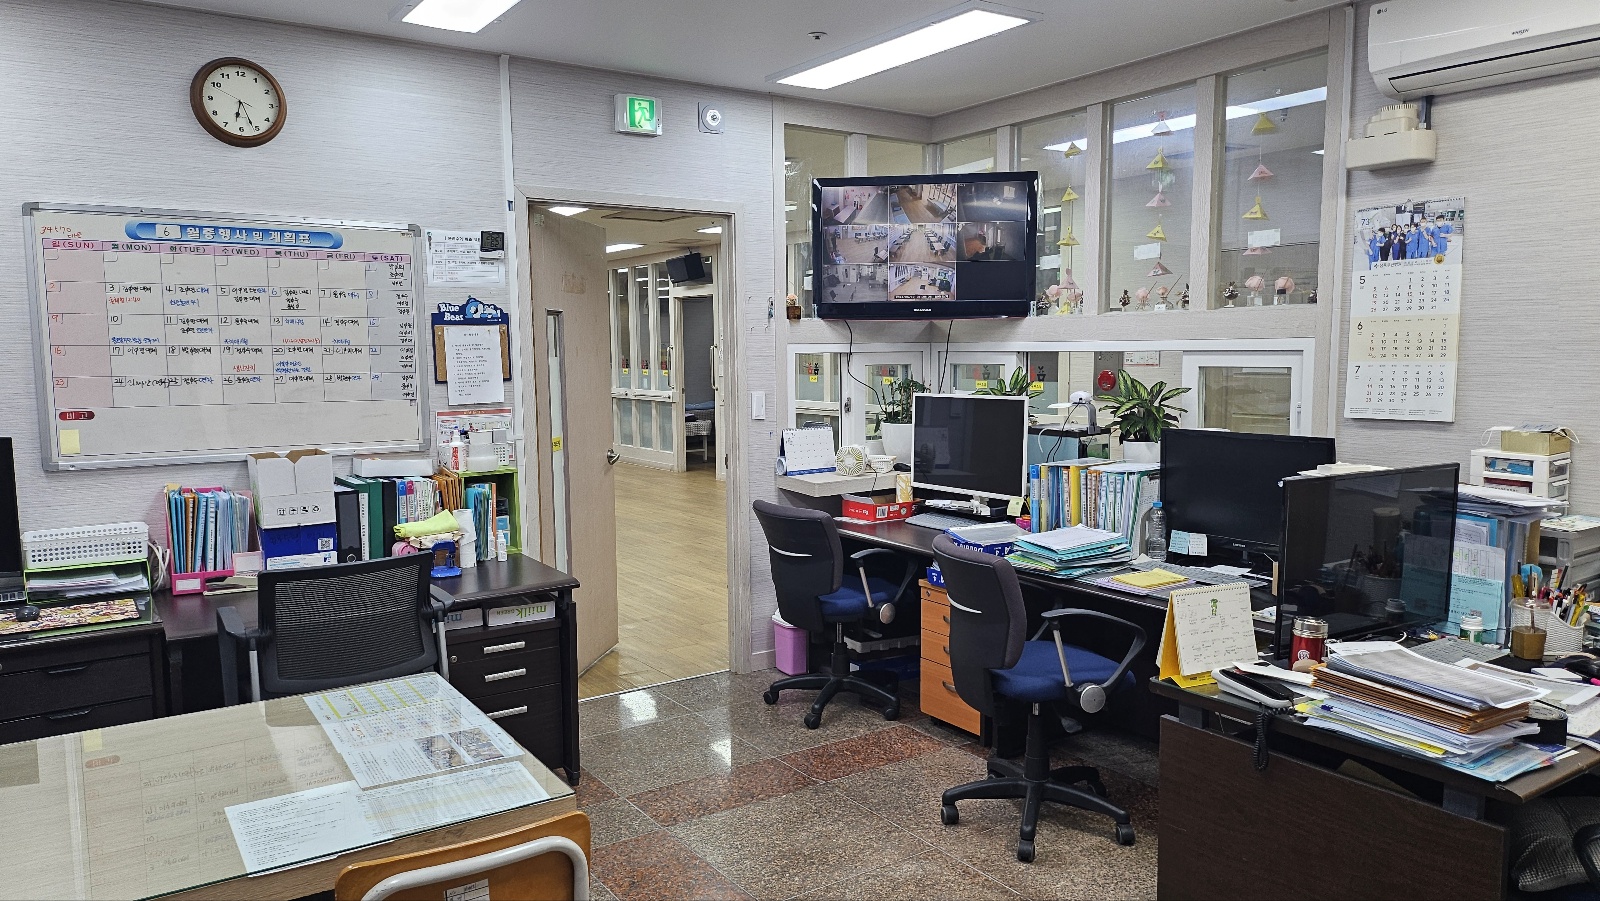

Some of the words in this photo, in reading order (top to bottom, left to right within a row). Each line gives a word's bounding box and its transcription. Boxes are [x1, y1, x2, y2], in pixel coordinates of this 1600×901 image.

[1361, 218, 1370, 226] 73
[164, 226, 170, 236] 6
[187, 227, 248, 241] 월중행사
[252, 231, 263, 241] 및
[269, 231, 311, 244] 계획표
[1360, 276, 1366, 284] 5
[439, 303, 460, 312] Blue
[322, 318, 331, 326] 14
[1357, 321, 1363, 330] 6
[168, 346, 176, 354] 18
[1355, 365, 1361, 374] 7
[55, 378, 64, 386] 23
[516, 605, 547, 618] miilk
